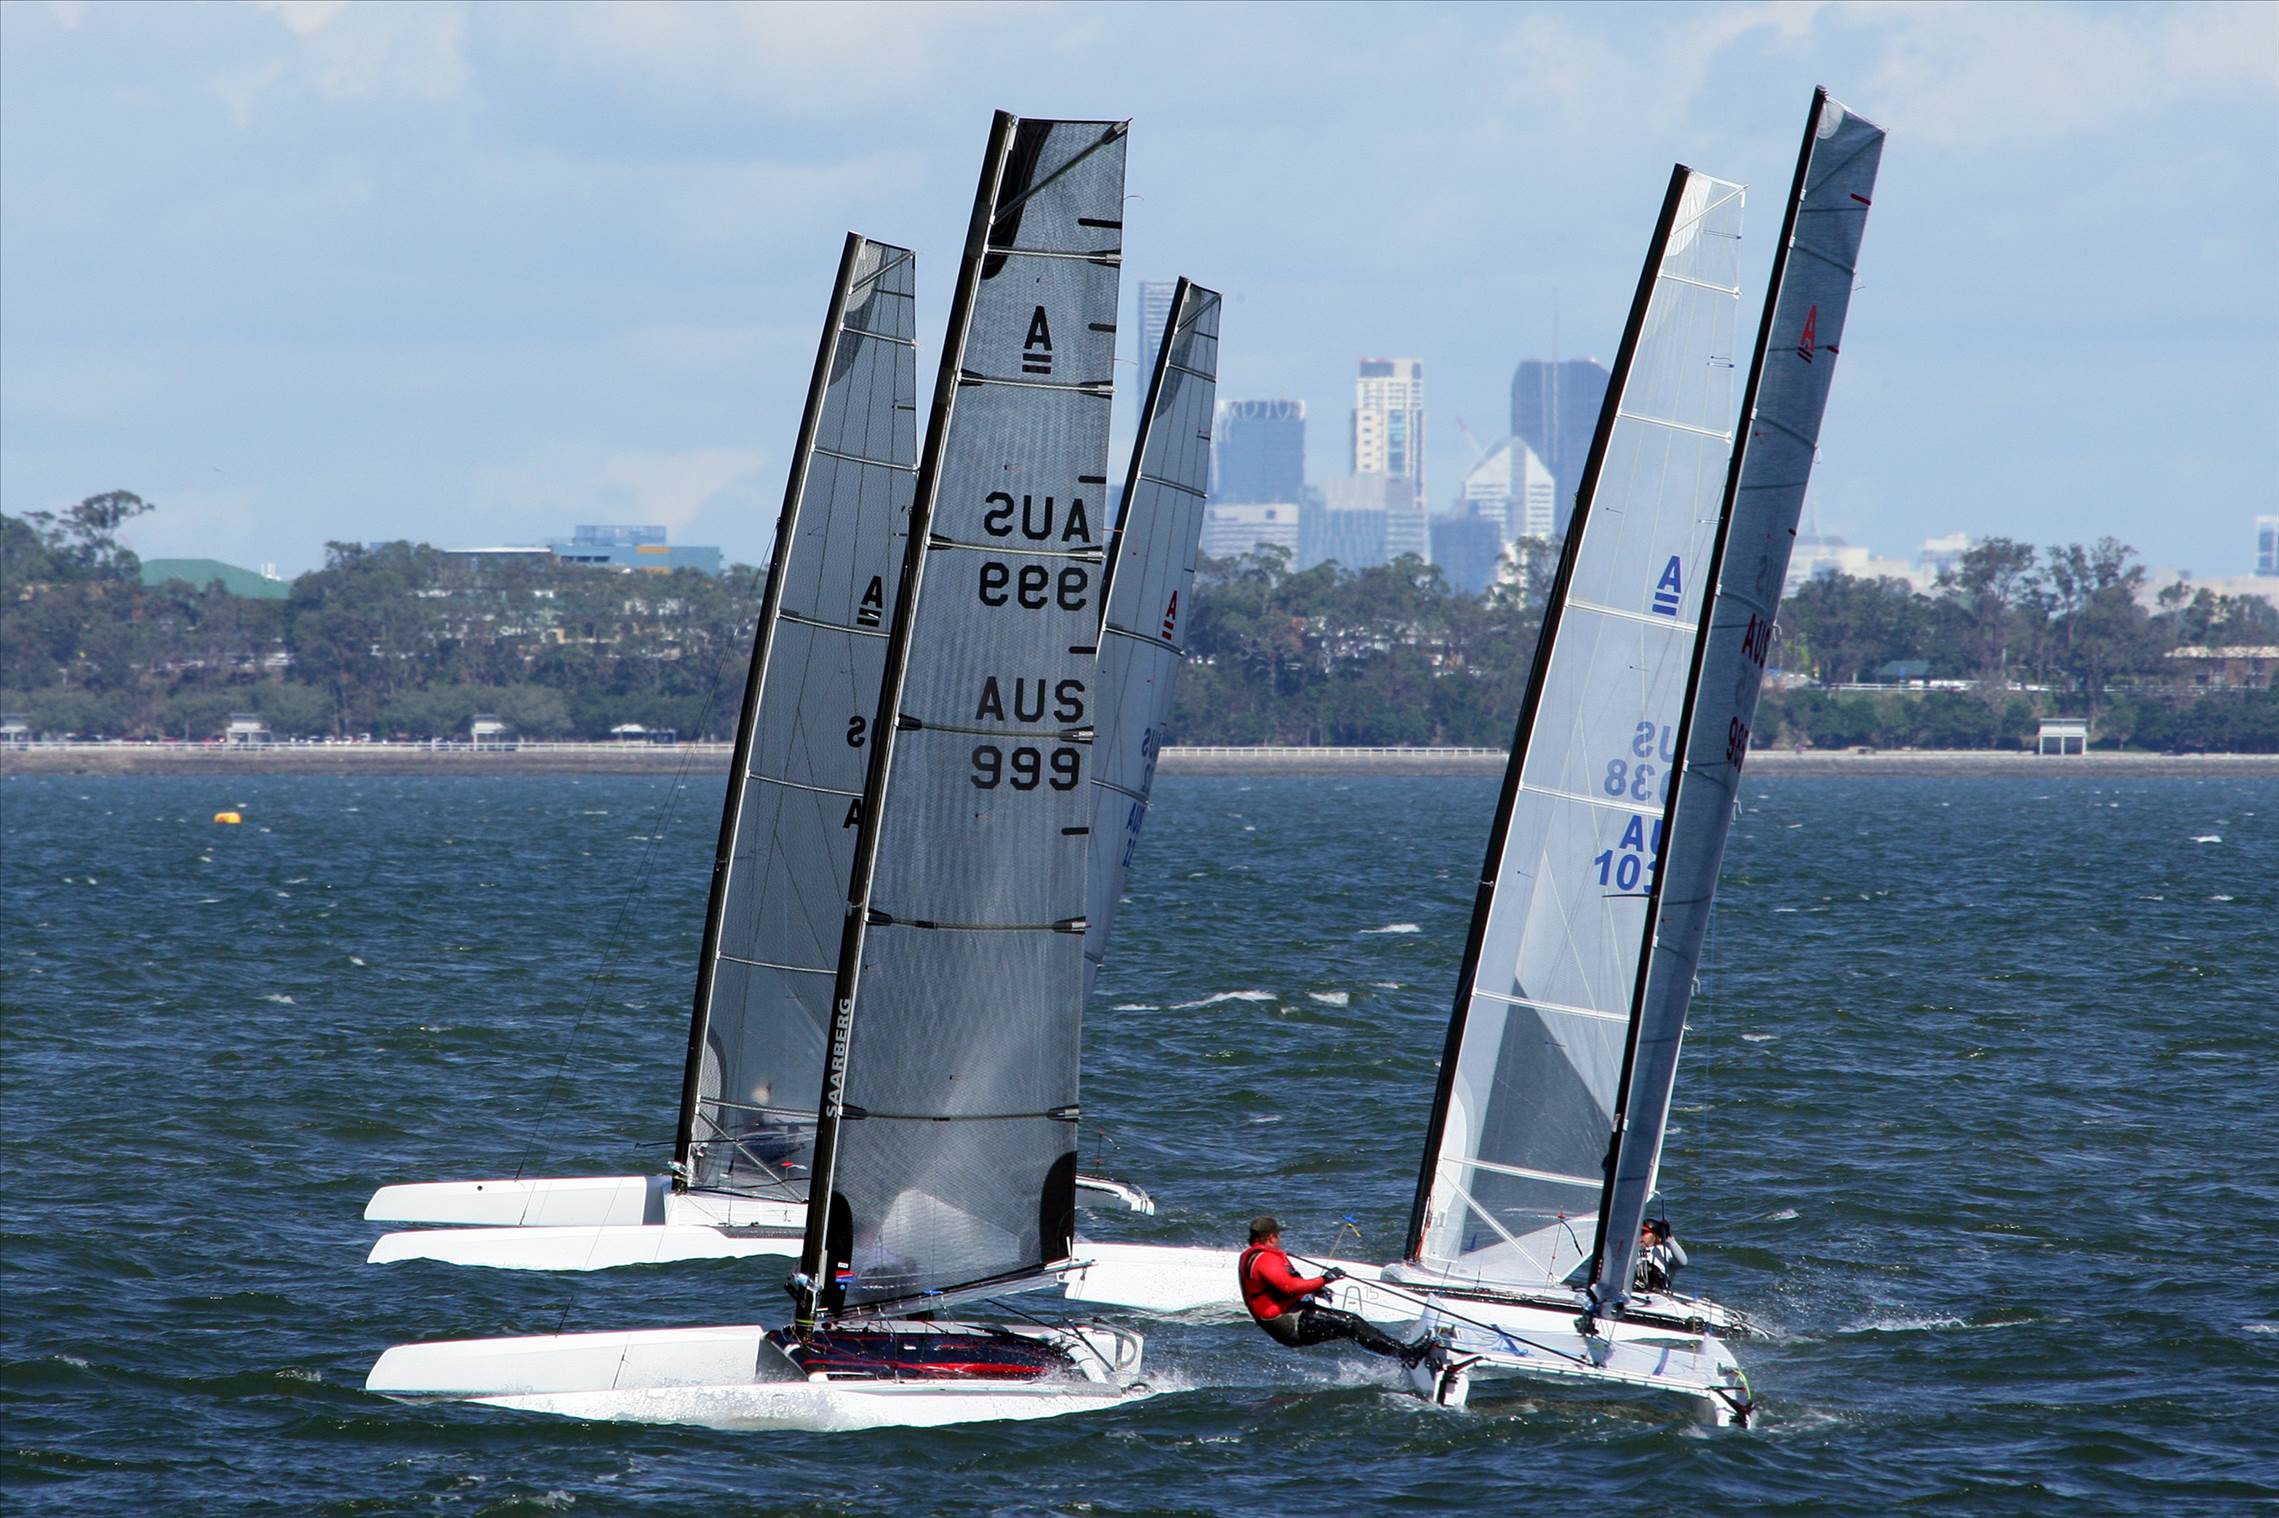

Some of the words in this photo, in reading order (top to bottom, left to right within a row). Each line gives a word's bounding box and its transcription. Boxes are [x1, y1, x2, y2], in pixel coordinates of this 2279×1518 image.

[1023, 305, 1053, 351] A
[1798, 304, 1818, 352] A
[861, 575, 883, 609] A
[1656, 555, 1682, 593] A
[1165, 590, 1178, 620] A
[975, 676, 1086, 723] AUS
[970, 744, 1081, 791] 999
[826, 998, 851, 1119] SAARBERG
